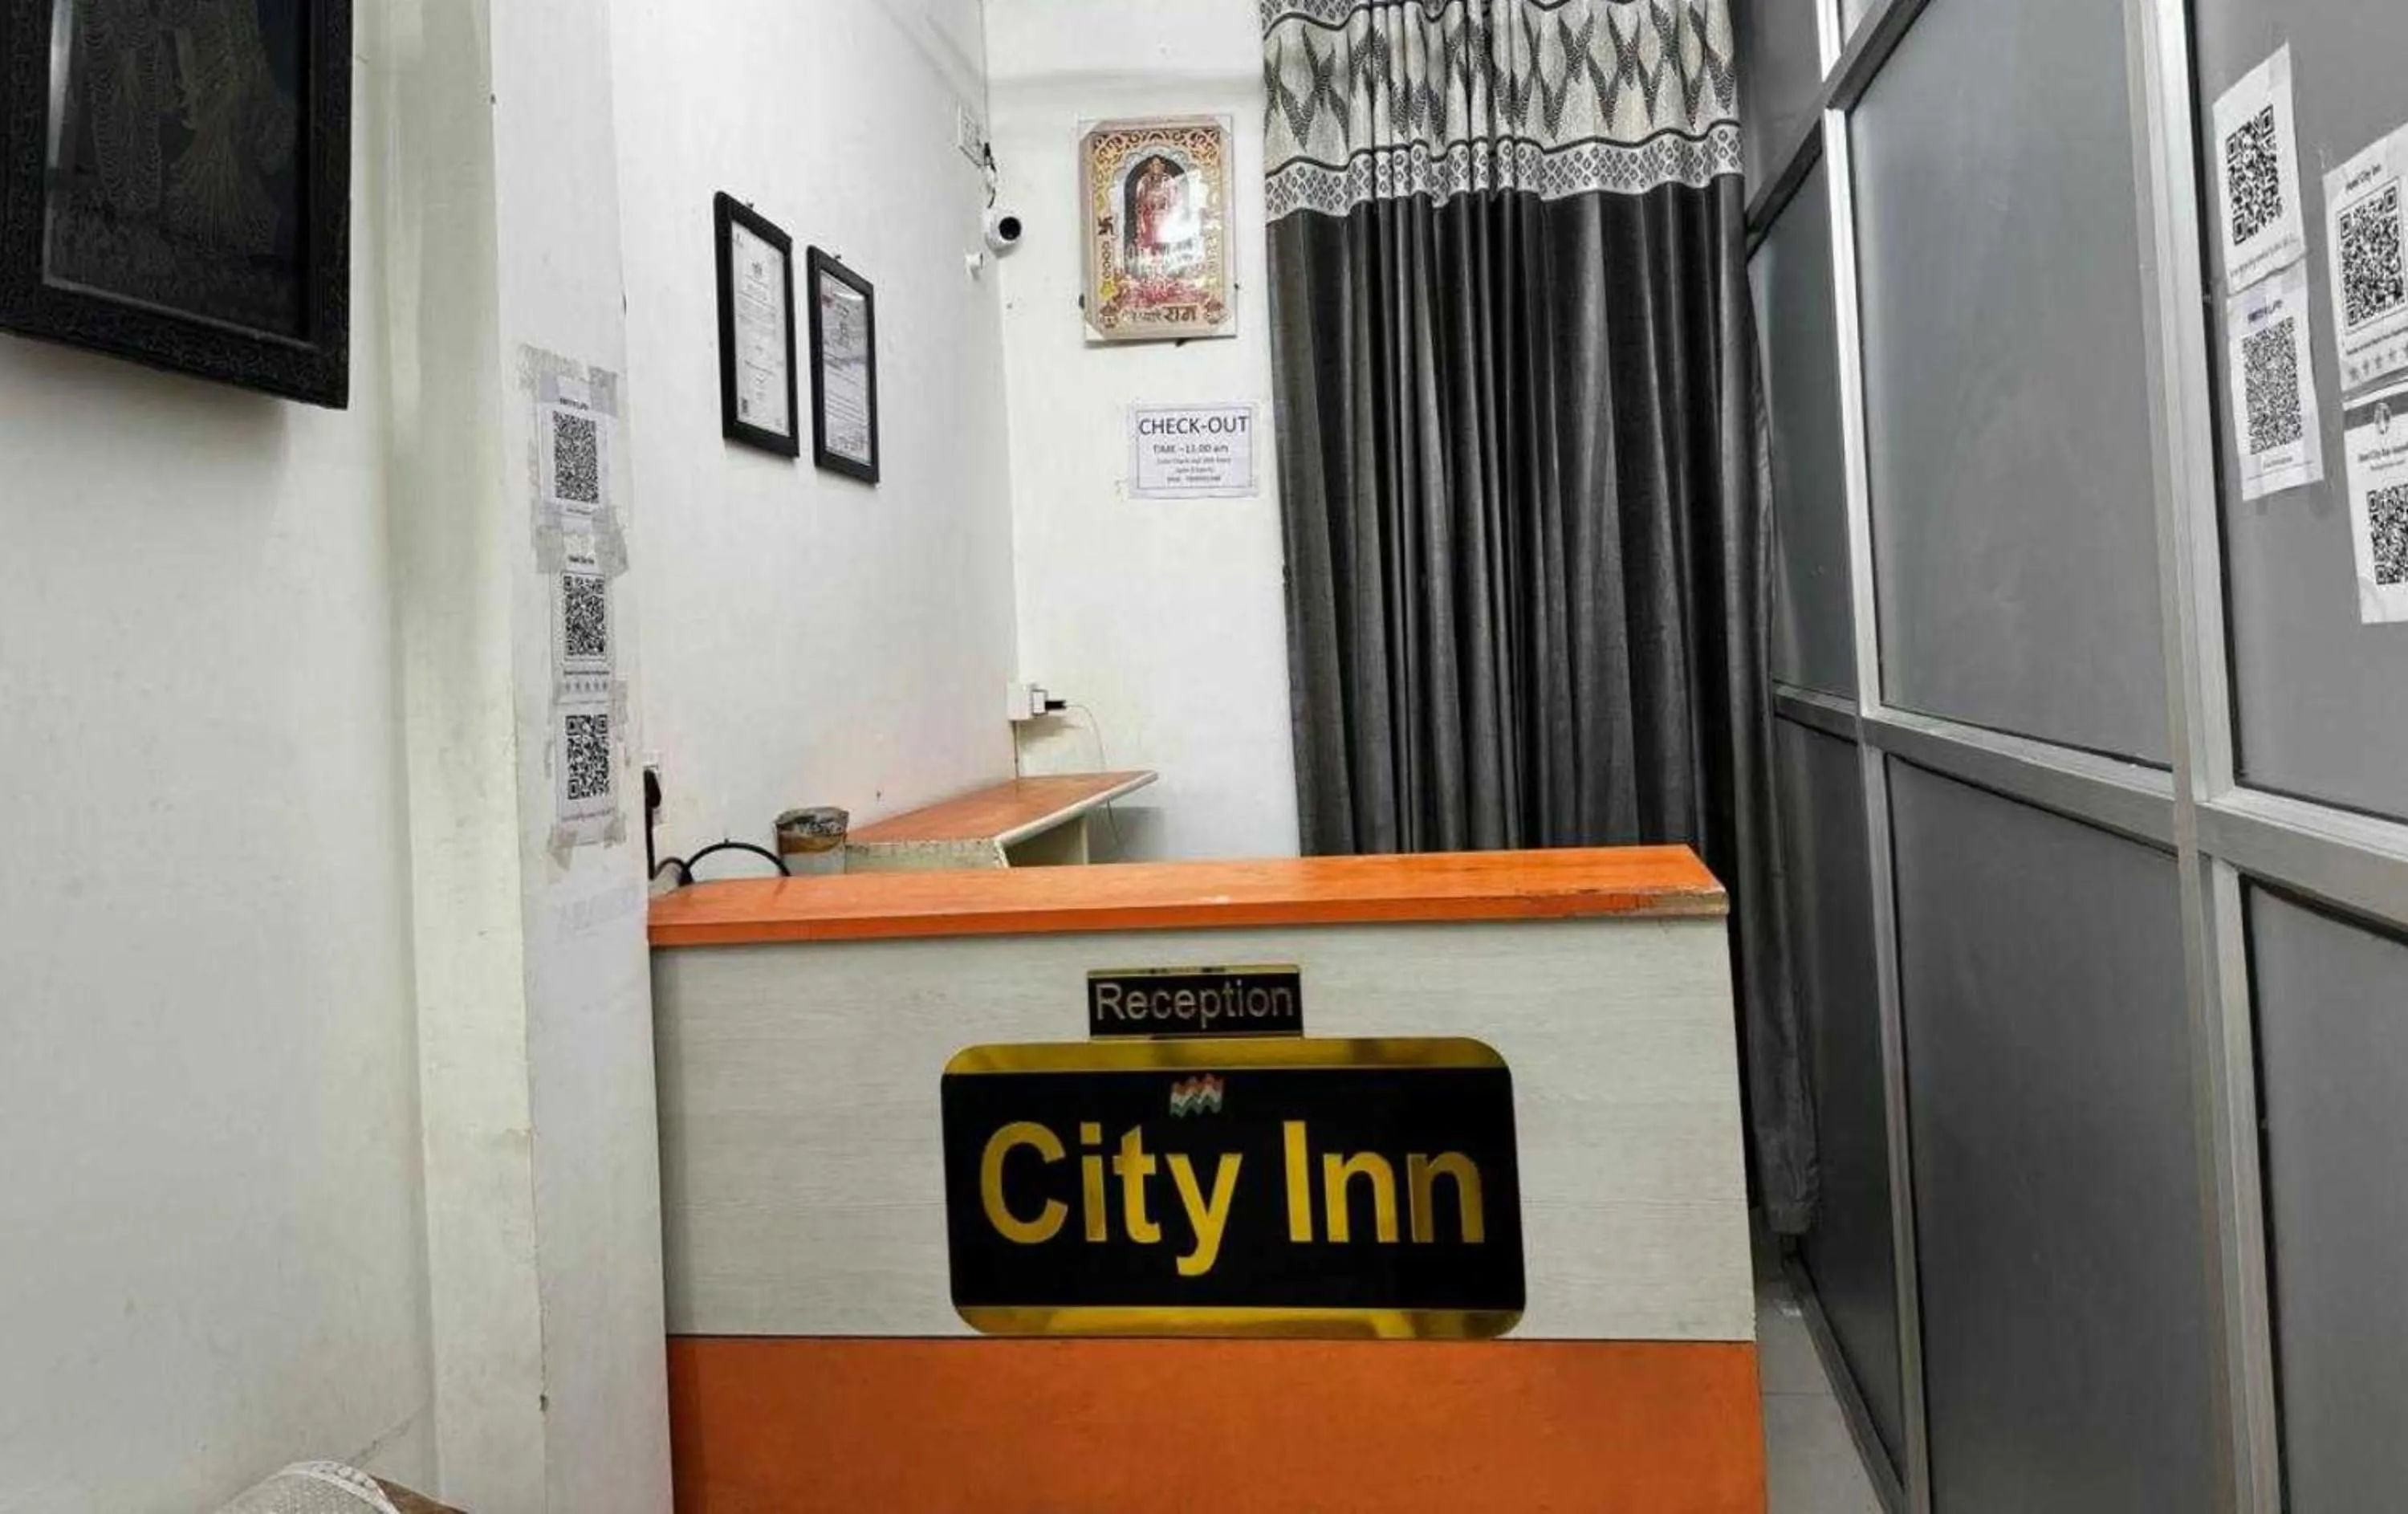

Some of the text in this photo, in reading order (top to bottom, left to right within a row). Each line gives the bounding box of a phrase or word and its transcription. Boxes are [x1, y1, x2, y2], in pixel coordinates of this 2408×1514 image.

[1138, 416, 1249, 435] CHECK-OUT
[1153, 445, 1175, 454] TIME
[1214, 445, 1229, 454] am
[1095, 979, 1294, 1028] Reception
[980, 1121, 1485, 1277] City Inn
